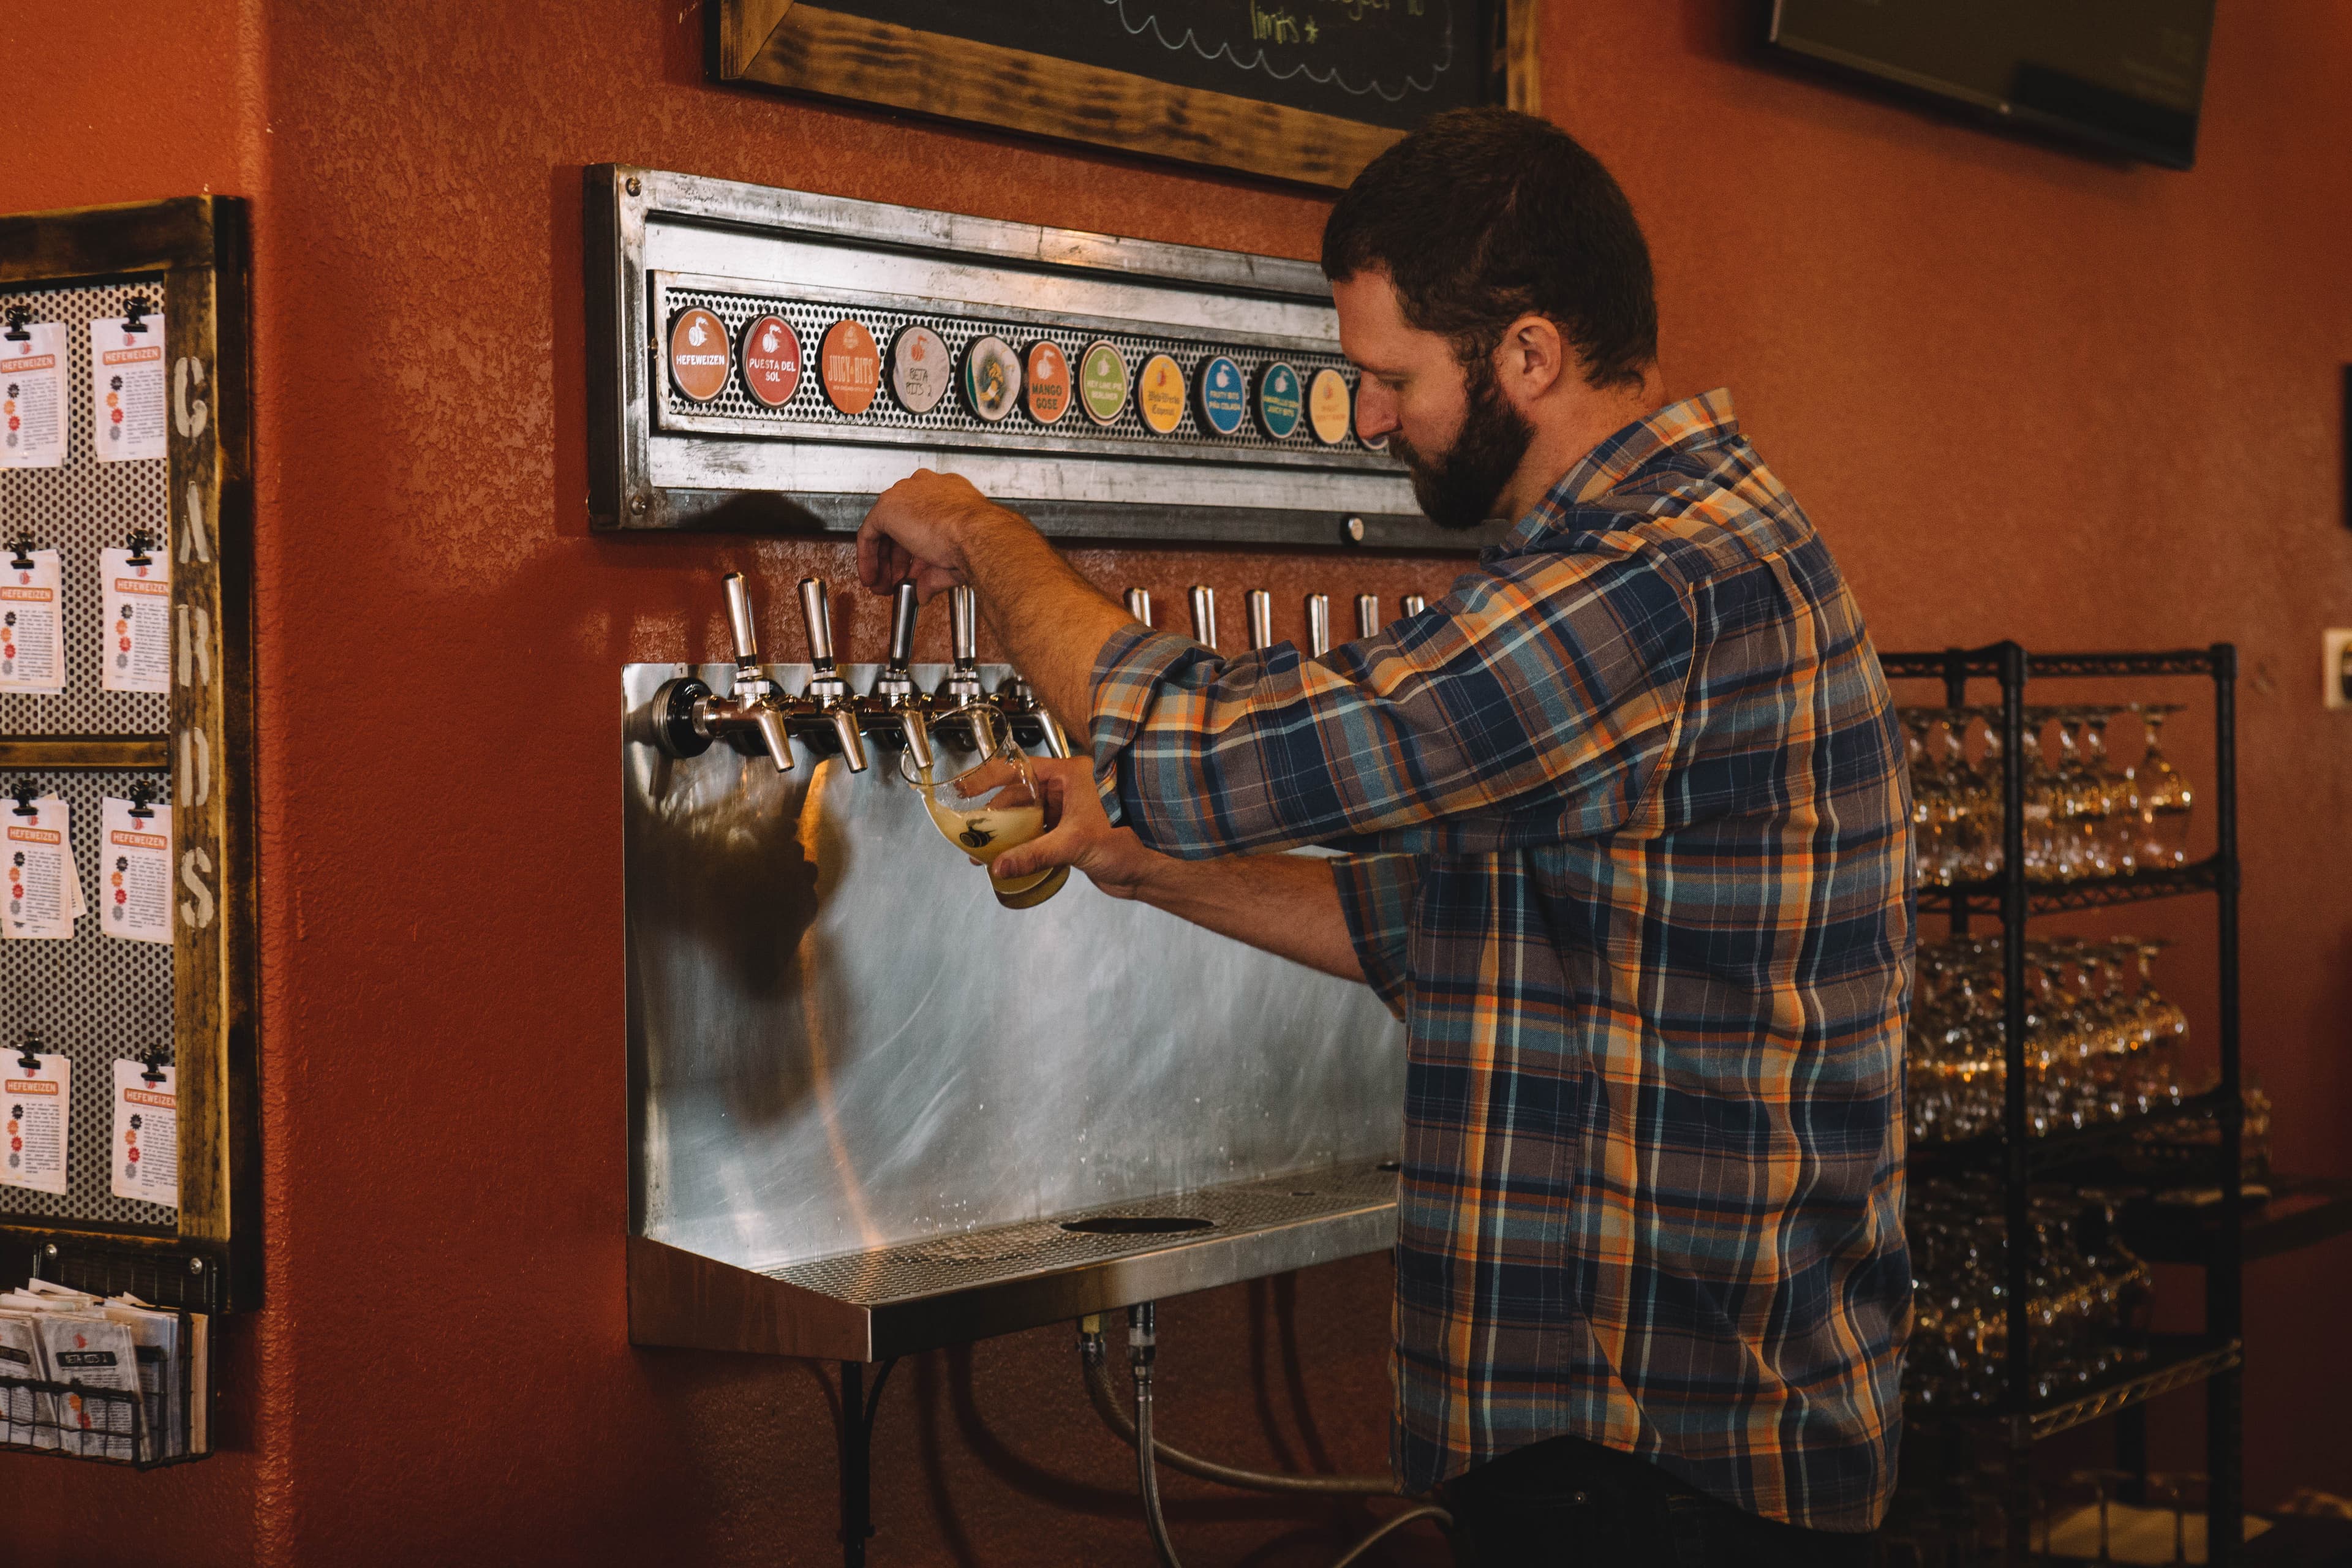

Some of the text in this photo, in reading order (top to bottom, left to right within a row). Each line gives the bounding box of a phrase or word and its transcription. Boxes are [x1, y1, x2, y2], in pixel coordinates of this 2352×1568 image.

[105, 349, 159, 362] HEFEWEIZEN
[676, 354, 725, 366] HEFEWEIZEN
[2, 356, 53, 369] HEFEWEIZEN
[749, 358, 796, 372] PUESTA DEL
[828, 355, 873, 385] JUICY BITS
[910, 368, 928, 383] BETA
[765, 372, 780, 382] SOL
[906, 382, 924, 396] BITS
[1032, 382, 1063, 396] MANGO
[1036, 398, 1058, 410] GOSE
[117, 581, 169, 594] HEFEWEIZEN
[2, 589, 51, 600] HEFEWEIZEN
[174, 356, 214, 929] CARDS
[10, 829, 59, 842] HEFEWEIZEN
[113, 833, 165, 847] HEFEWEIZEN
[7, 1082, 56, 1093] HEFEWEIZEN
[127, 1091, 176, 1106] HEFEWEIZEN
